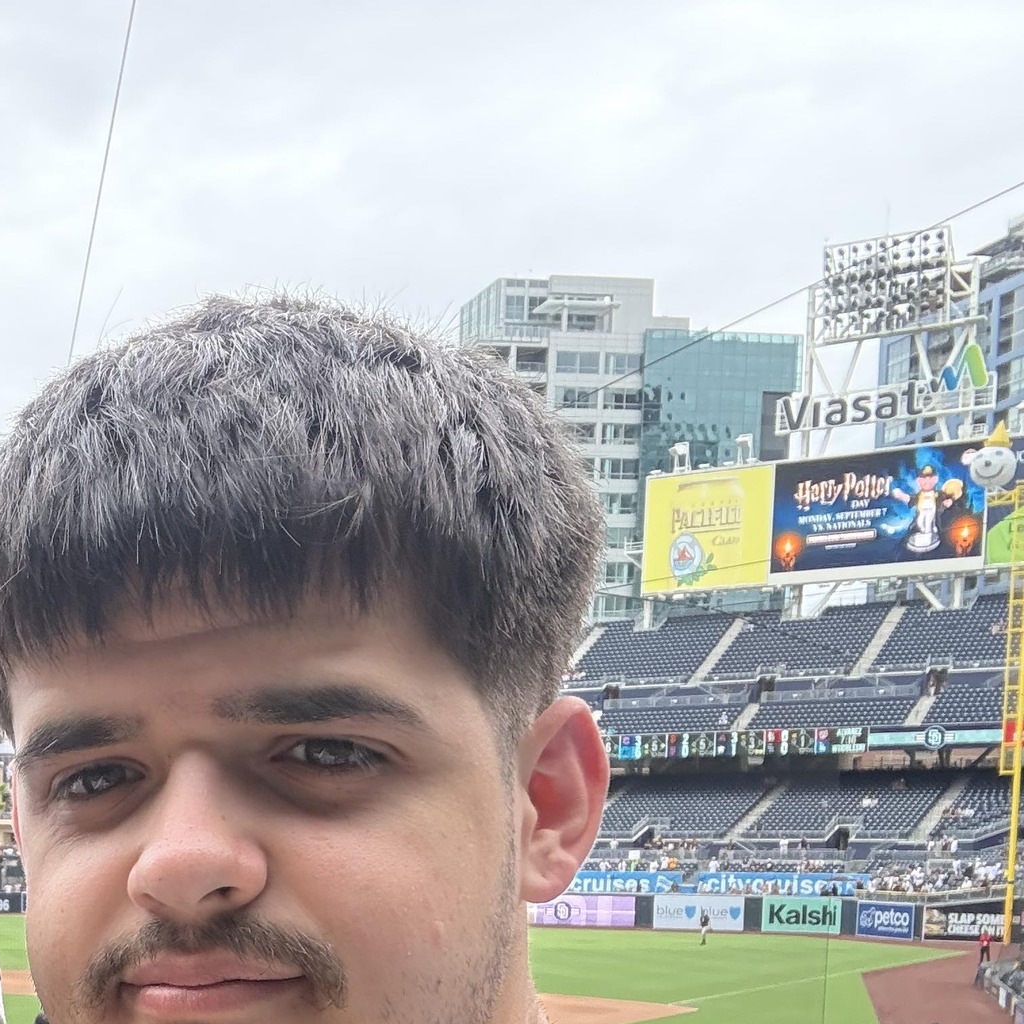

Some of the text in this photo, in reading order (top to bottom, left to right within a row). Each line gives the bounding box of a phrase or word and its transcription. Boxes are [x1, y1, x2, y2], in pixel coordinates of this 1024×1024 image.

[782, 381, 923, 430] Viasat
[794, 472, 894, 512] Harry Potter
[851, 498, 871, 509] DAY
[573, 874, 650, 894] cruises
[657, 905, 683, 915] blue
[768, 903, 838, 926] Kalshi
[874, 908, 910, 928] petco
[948, 913, 975, 924] SLAP
[948, 925, 980, 936] CHEESE
